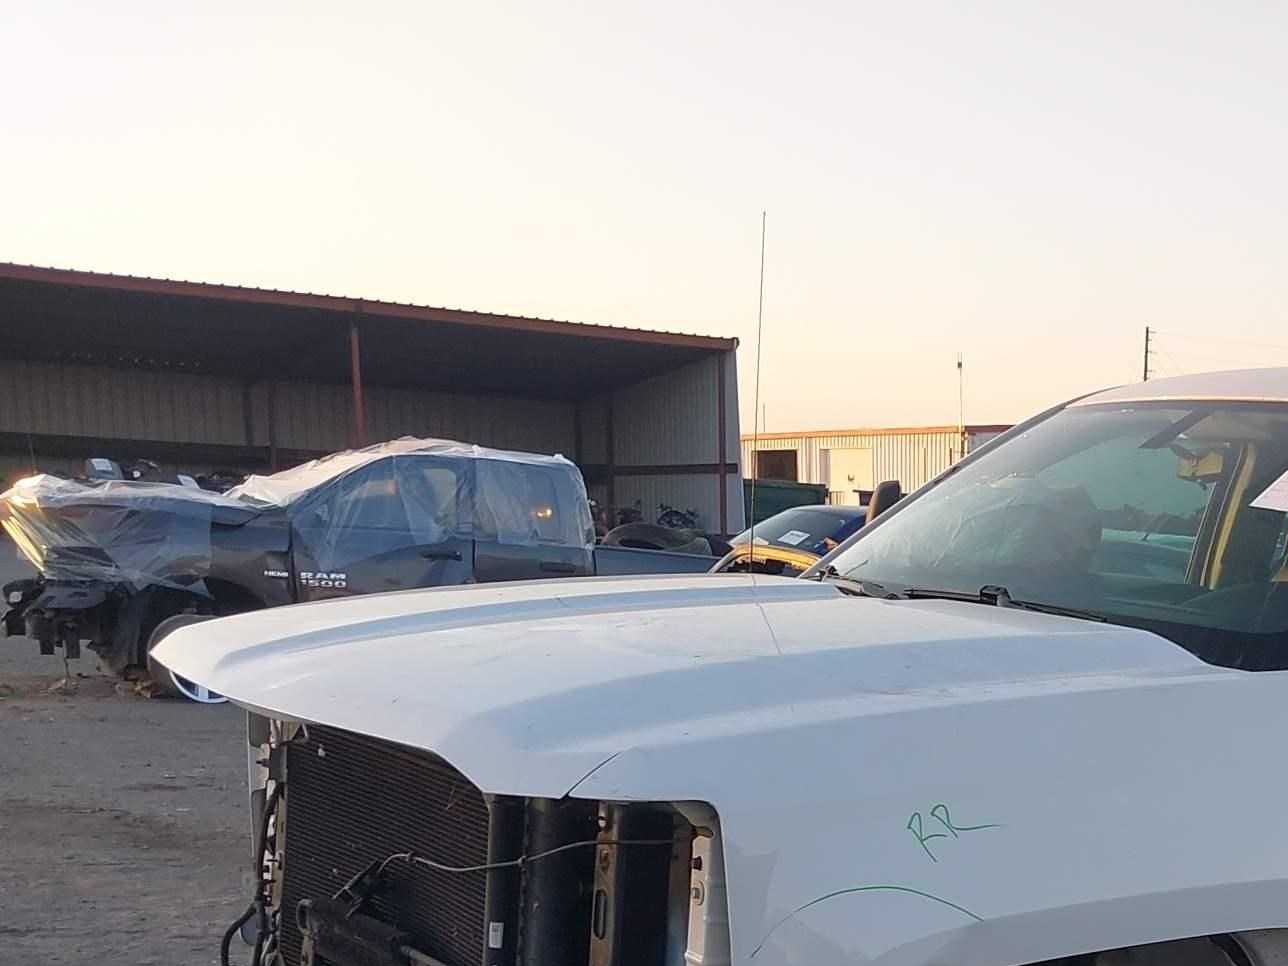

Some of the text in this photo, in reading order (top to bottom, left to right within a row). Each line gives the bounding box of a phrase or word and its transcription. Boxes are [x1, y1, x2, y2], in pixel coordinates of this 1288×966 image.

[264, 570, 289, 578] HEMI
[300, 571, 346, 579] RAM
[301, 579, 347, 588] 1500
